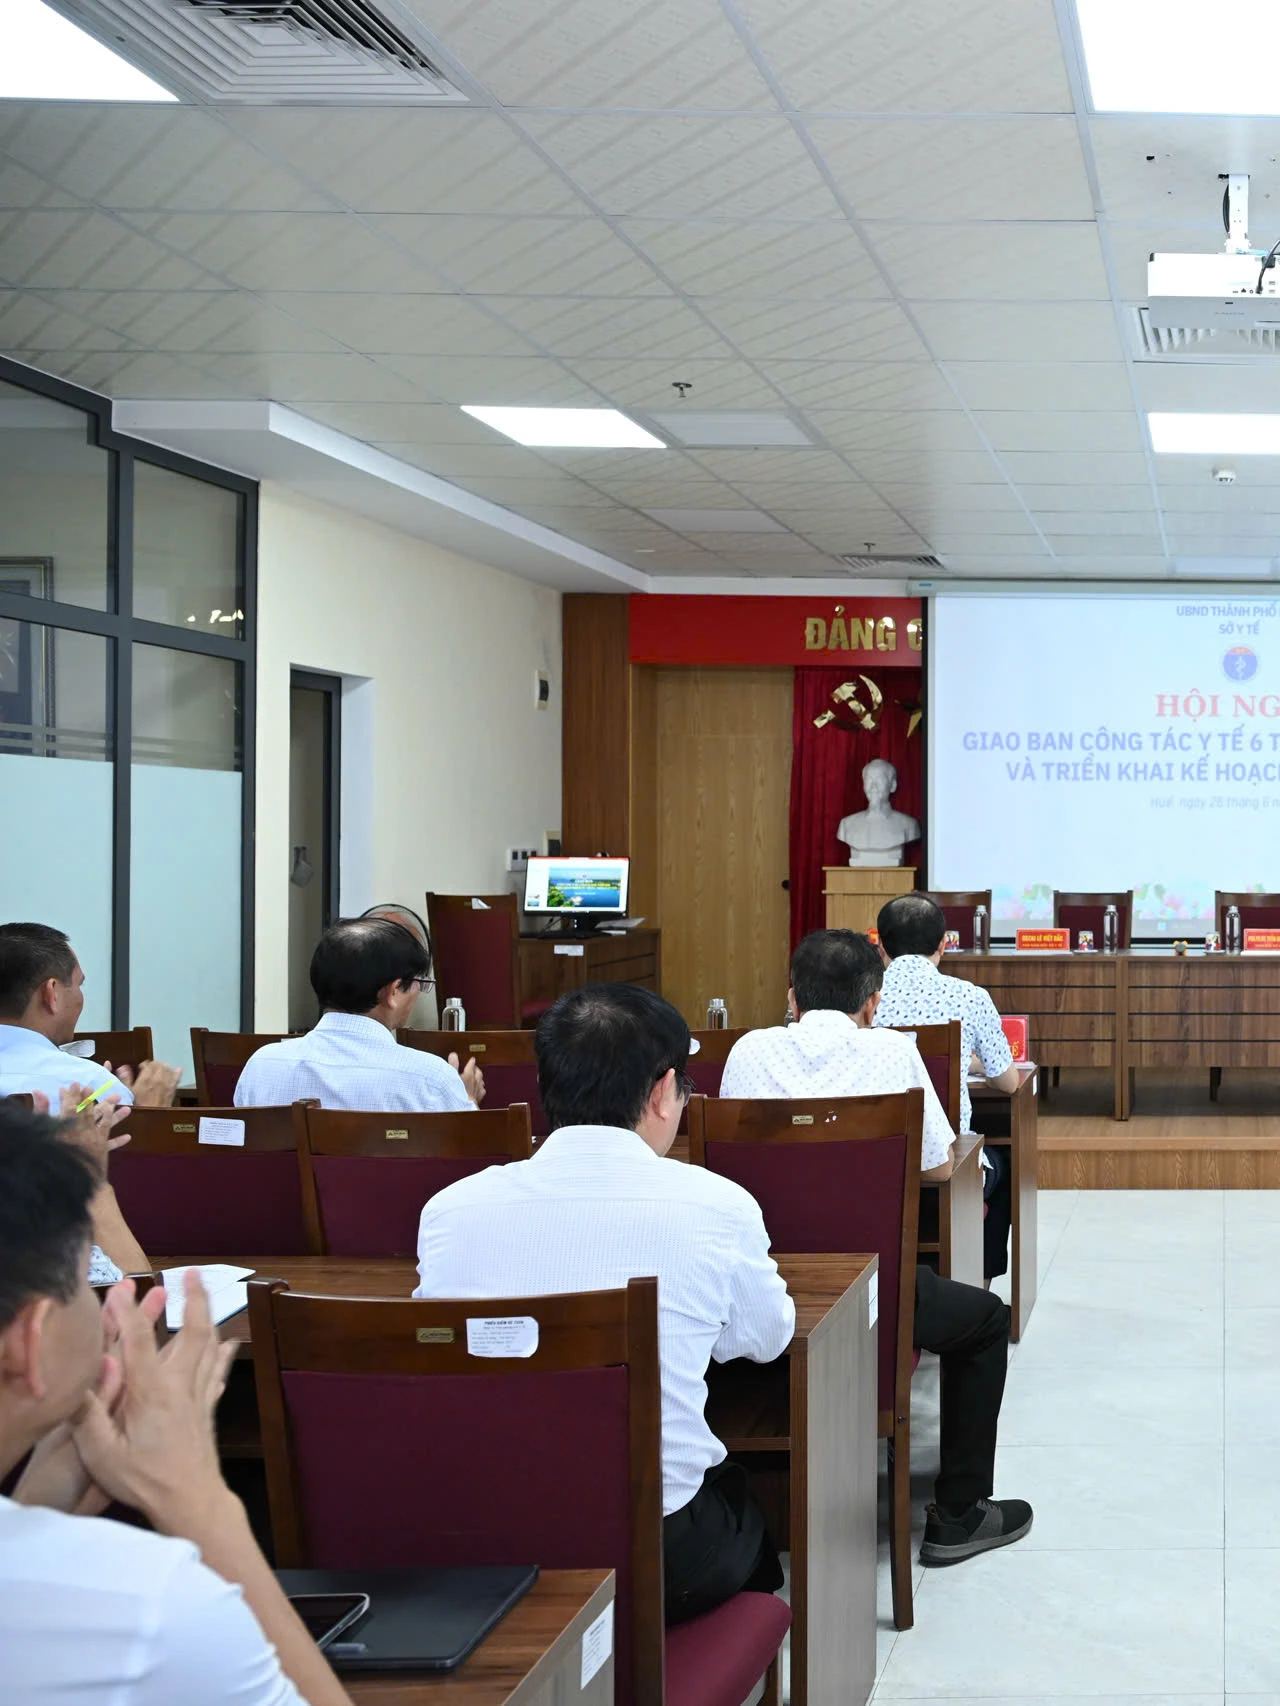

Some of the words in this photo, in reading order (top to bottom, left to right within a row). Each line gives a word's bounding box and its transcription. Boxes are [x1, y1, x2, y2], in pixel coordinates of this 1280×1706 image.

[1176, 605, 1208, 617] UBND
[1210, 602, 1251, 617] THÀNH
[1253, 600, 1276, 617] PHỐ
[804, 605, 898, 651] ĐẢNG
[1218, 620, 1234, 634] SỞ
[1236, 624, 1245, 634] Y
[1247, 619, 1260, 635] TẾ
[1155, 688, 1220, 723] HỘI
[962, 731, 1021, 751] GIAO
[1027, 732, 1074, 751] BAN
[1079, 726, 1143, 752] CÔNG
[1149, 726, 1192, 752] TÁC
[1198, 732, 1212, 751] Y
[1217, 723, 1245, 752] TẾ
[1250, 733, 1263, 753] 6
[1005, 756, 1037, 782] VÀ
[1041, 752, 1111, 782] TRIỂN
[1117, 762, 1175, 782] KHAI
[1180, 753, 1211, 782] KẾ
